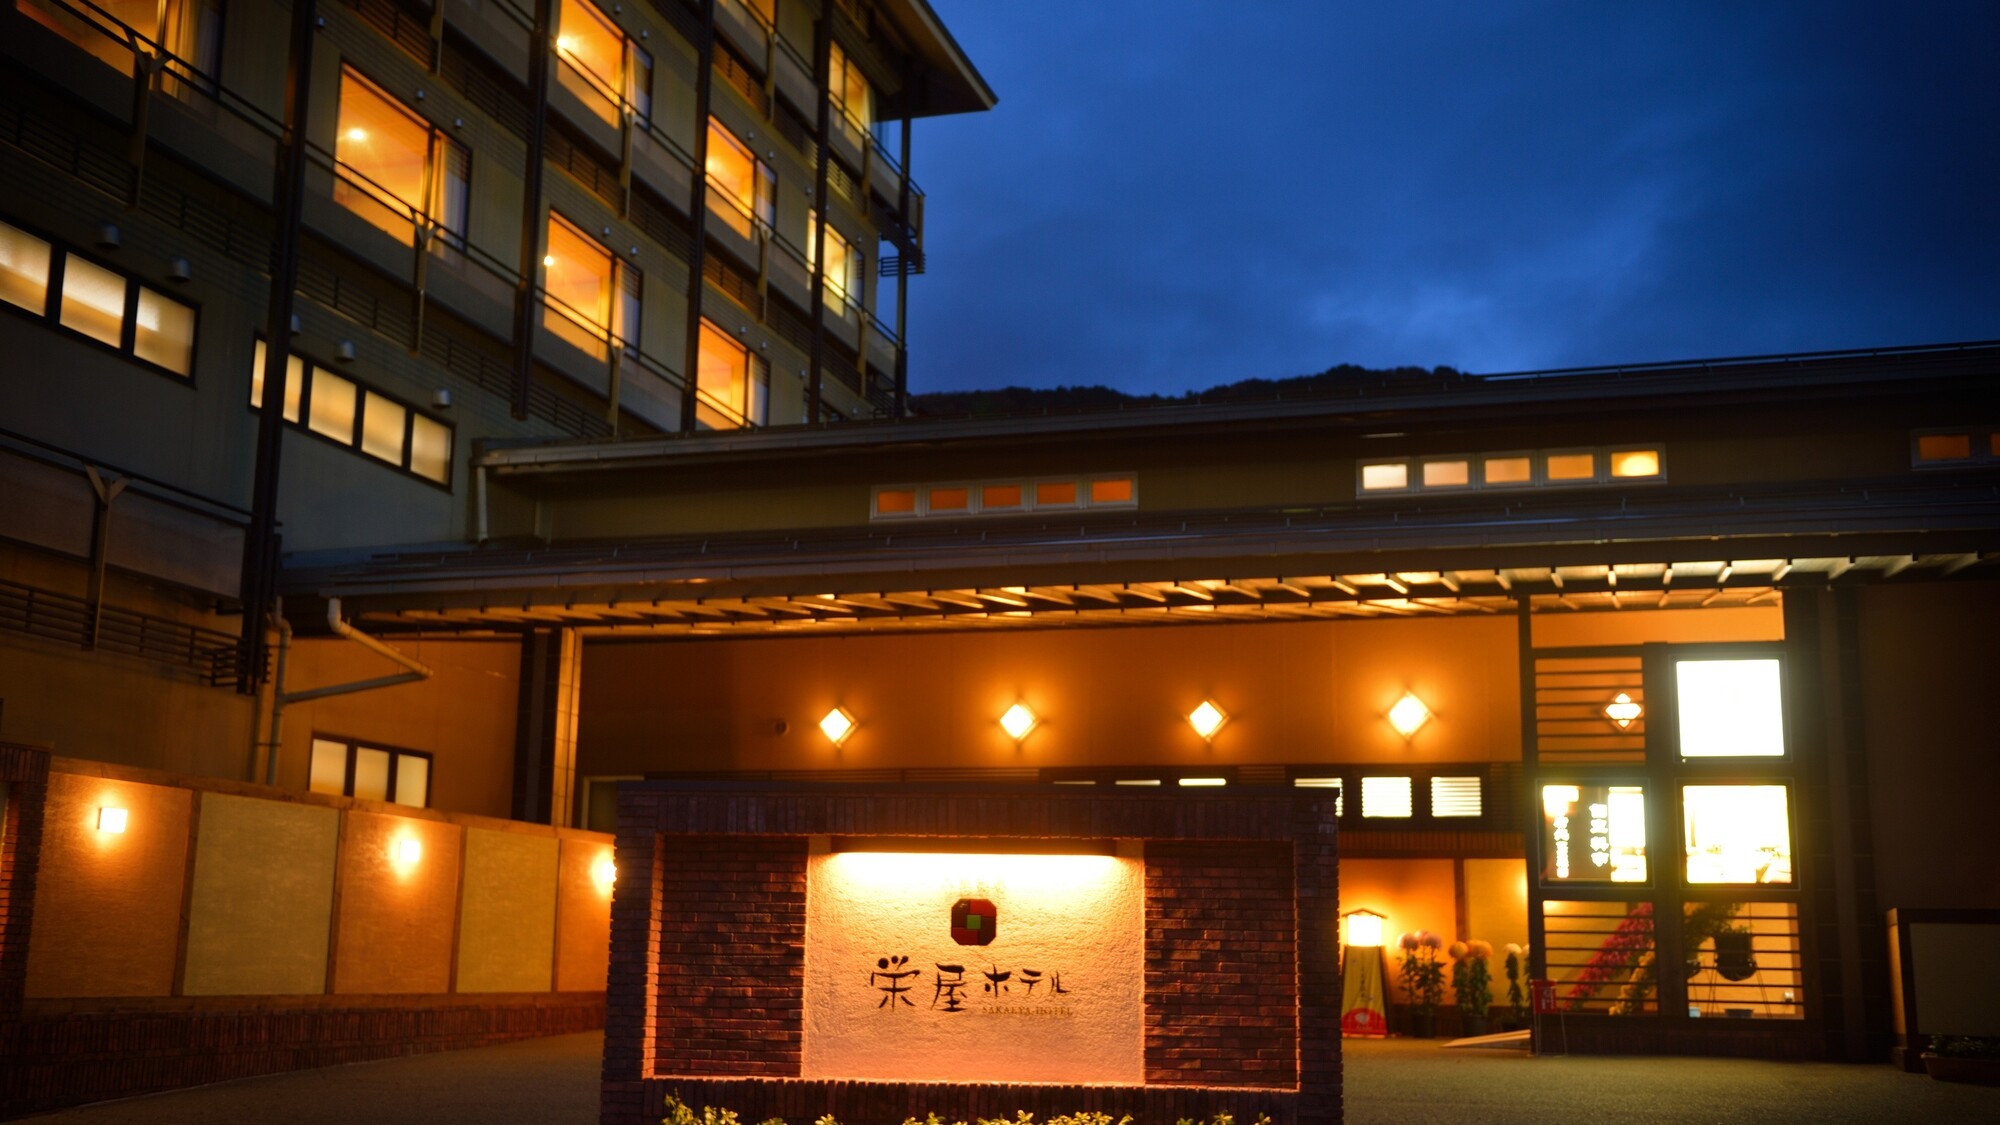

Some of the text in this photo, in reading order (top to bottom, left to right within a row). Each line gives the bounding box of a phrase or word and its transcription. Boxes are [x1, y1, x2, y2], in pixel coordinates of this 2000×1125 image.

[870, 955, 1072, 1012] 栄屋ホテル
